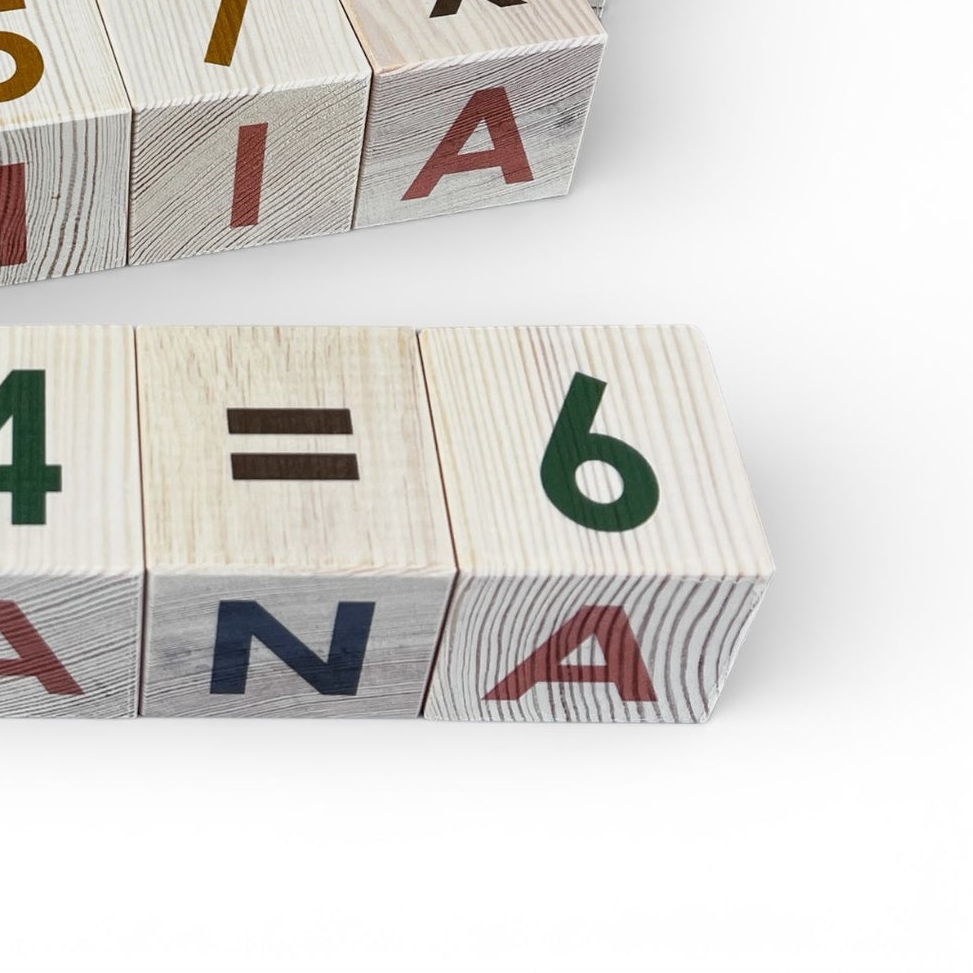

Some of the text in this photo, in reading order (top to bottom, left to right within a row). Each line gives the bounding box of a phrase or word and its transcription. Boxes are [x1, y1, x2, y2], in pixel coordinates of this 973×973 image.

[229, 122, 269, 229] I
[401, 86, 534, 201] A
[539, 372, 660, 534] 6
[209, 600, 376, 696] N
[483, 604, 658, 702] A
